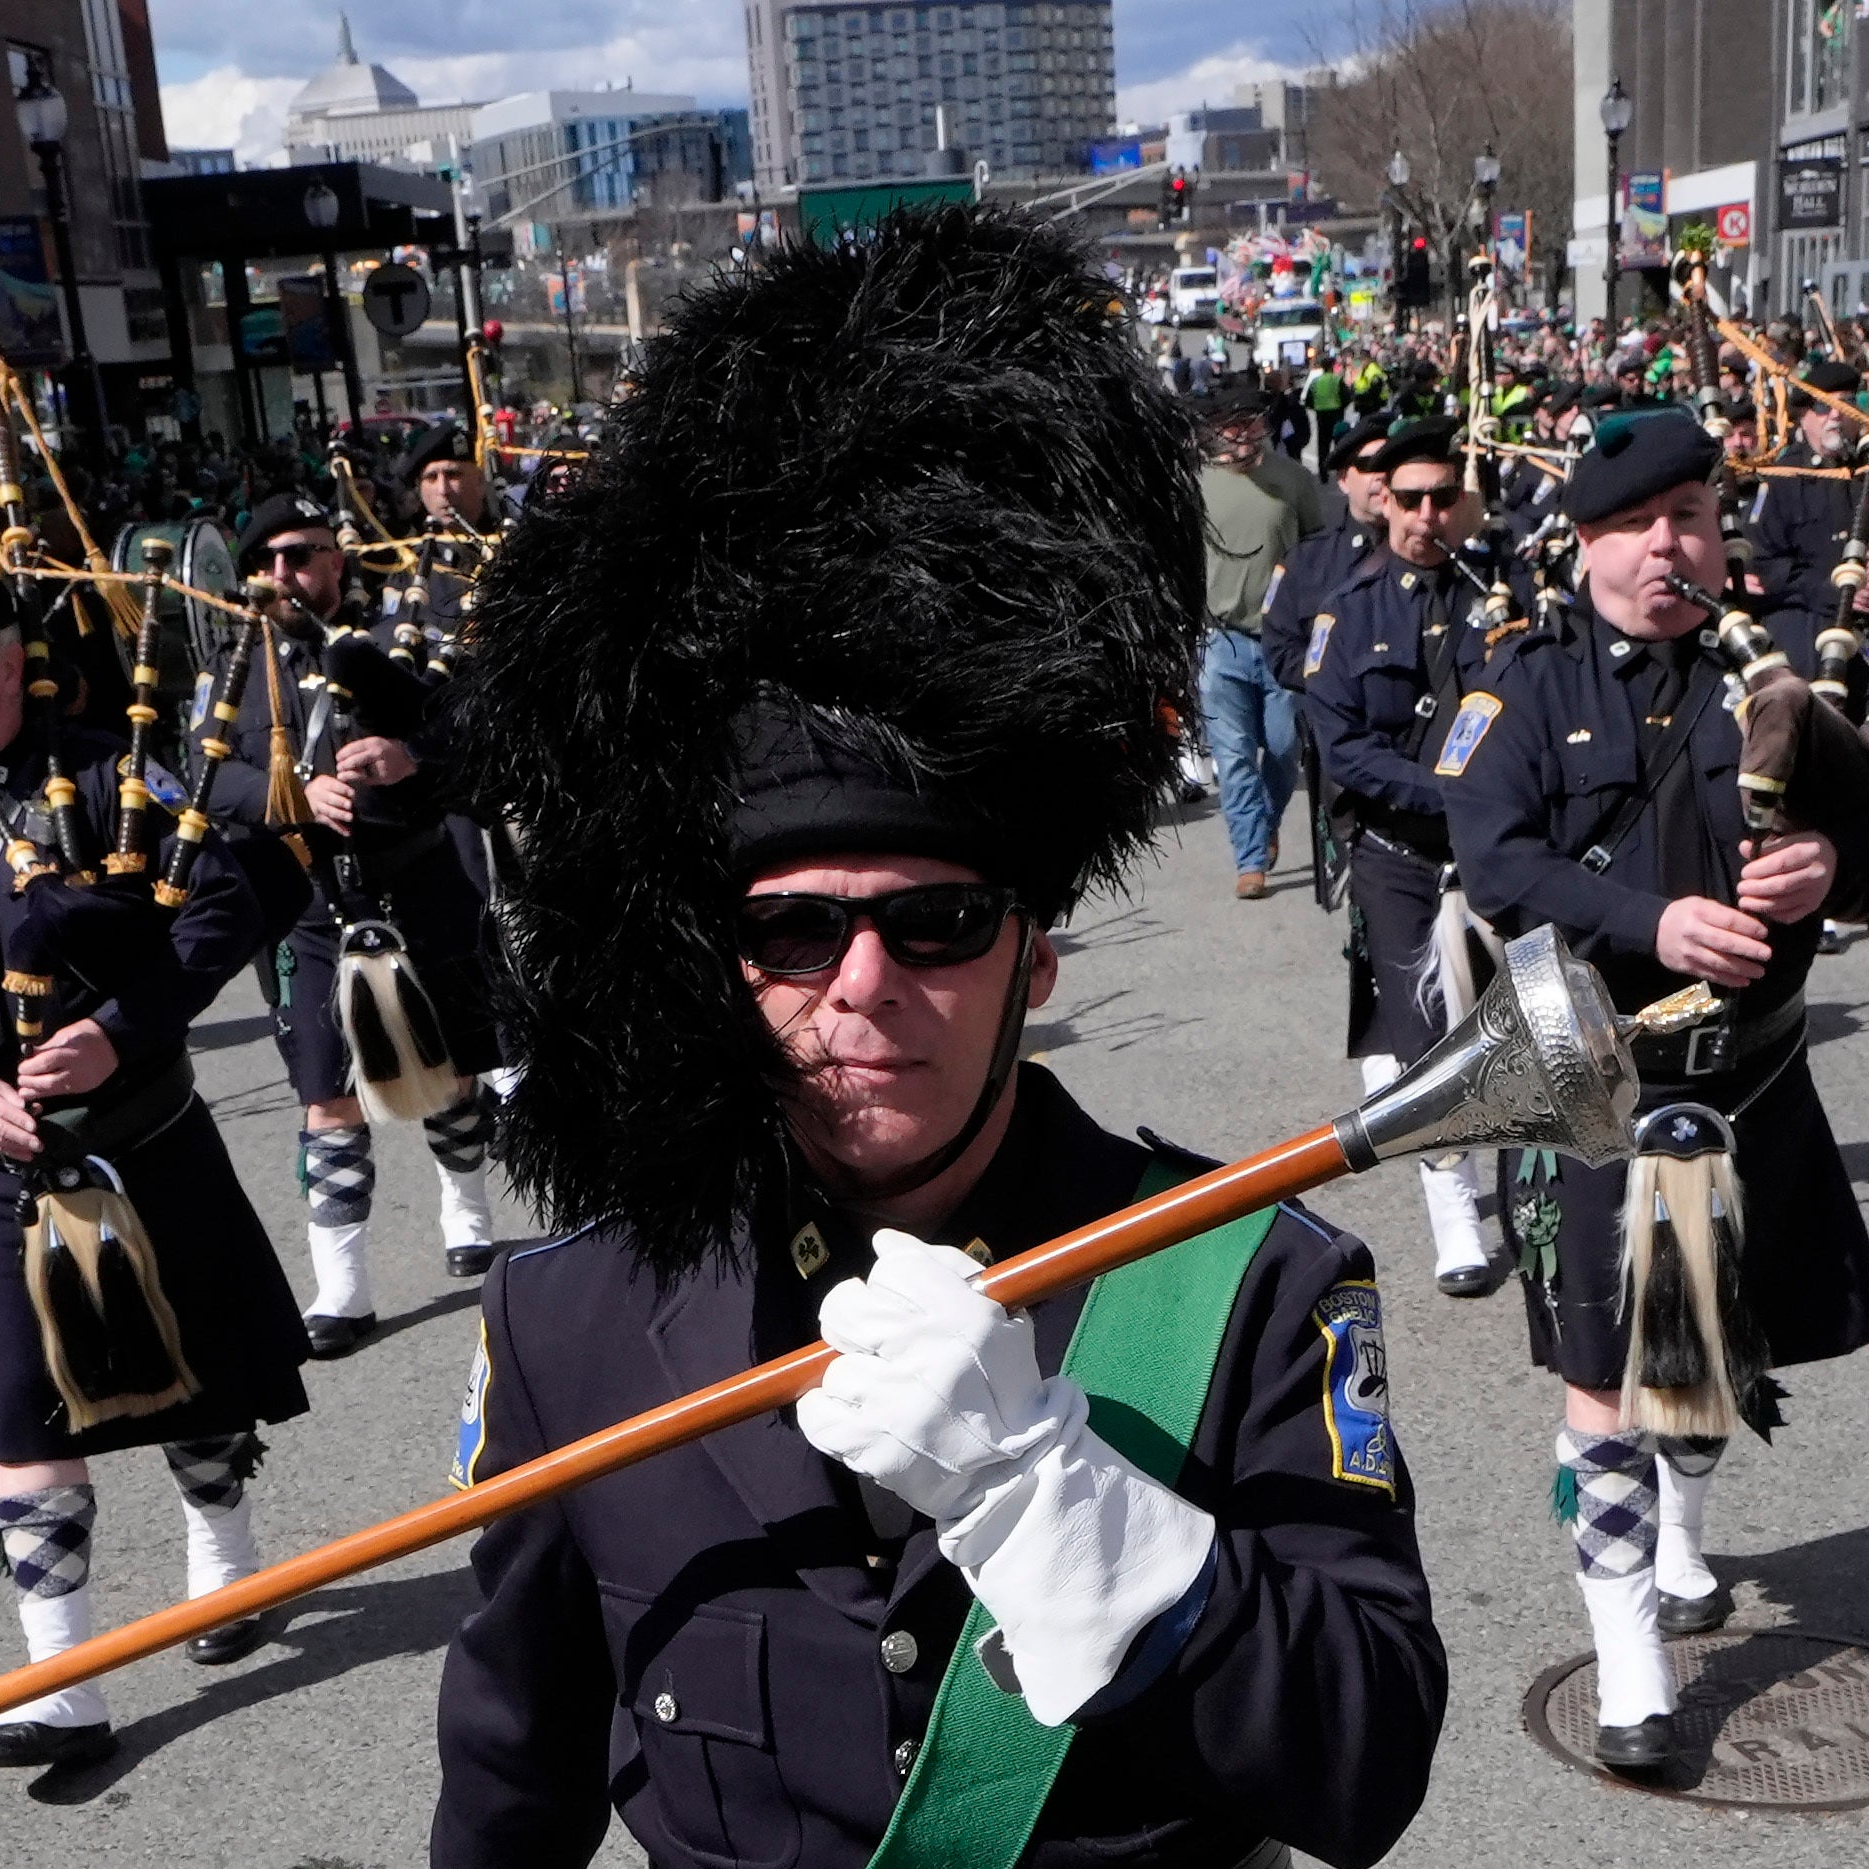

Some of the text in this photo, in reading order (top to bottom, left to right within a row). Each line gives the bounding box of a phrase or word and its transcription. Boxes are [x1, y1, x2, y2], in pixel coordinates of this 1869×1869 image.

[373, 281, 418, 325] T
[1318, 1290, 1376, 1313] BOSTON
[1330, 1305, 1377, 1324] GAELIC
